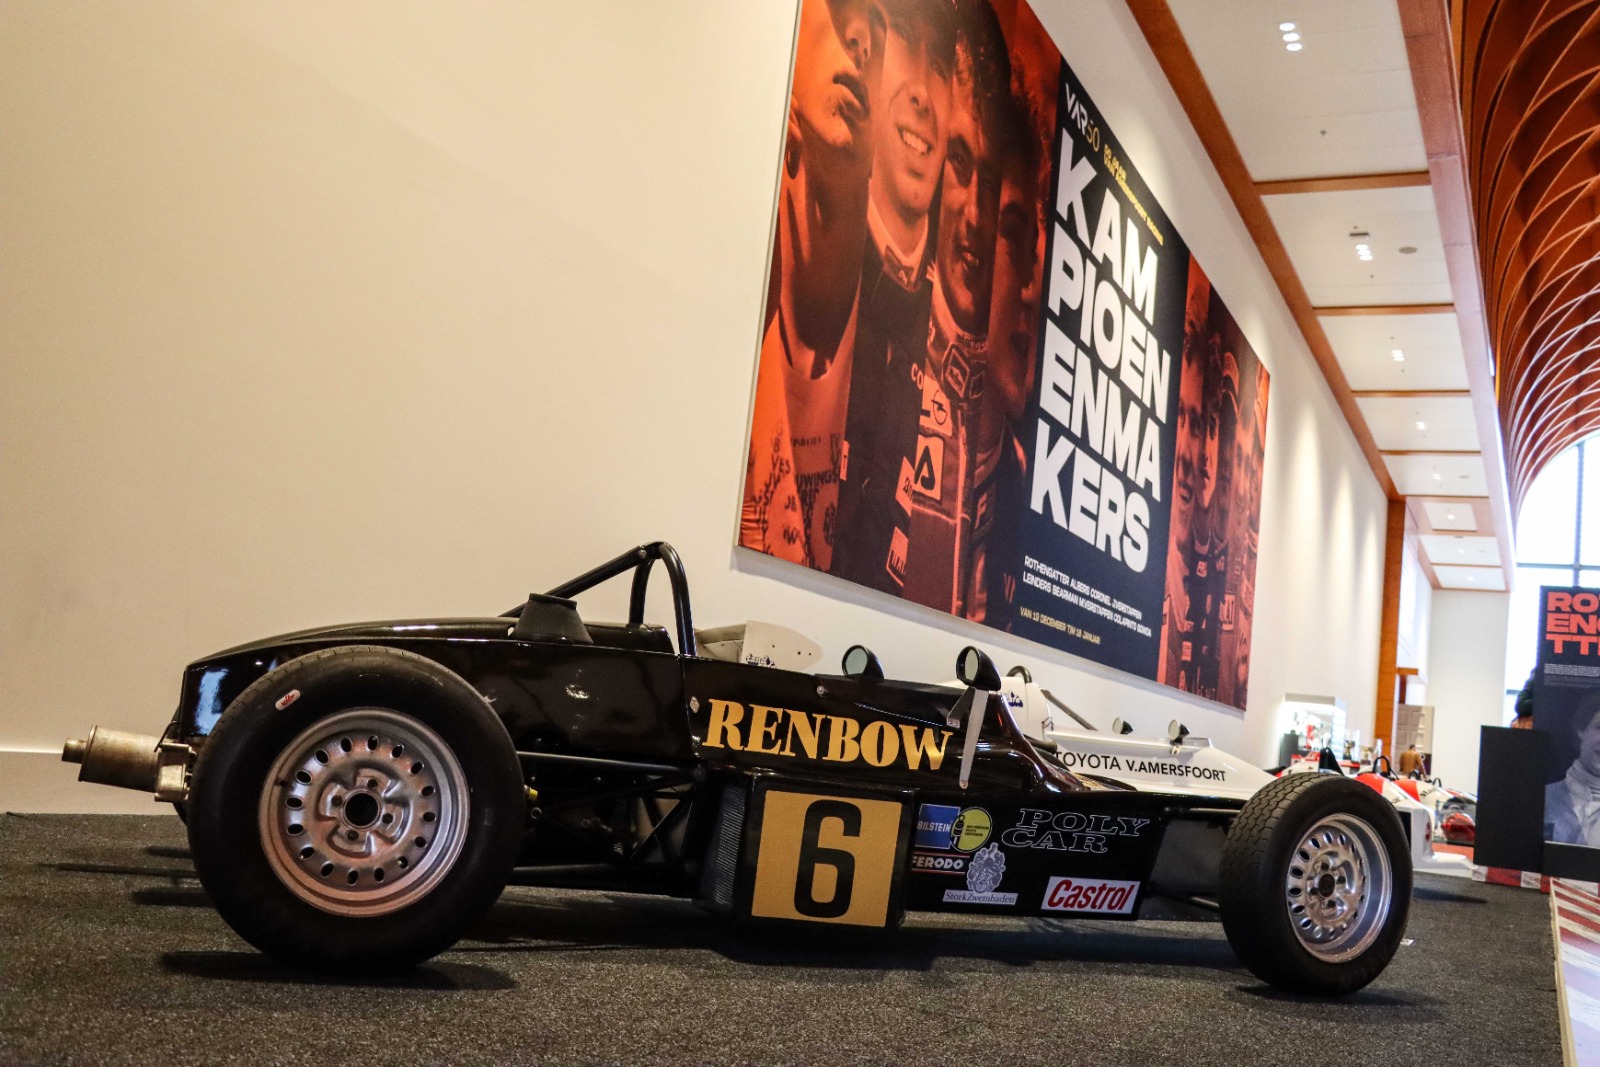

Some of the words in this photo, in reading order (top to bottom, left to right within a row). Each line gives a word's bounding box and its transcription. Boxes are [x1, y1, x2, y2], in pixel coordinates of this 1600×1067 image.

[1055, 127, 1158, 325] KAM
[1048, 221, 1171, 424] PIOEN
[1039, 318, 1161, 502] ENMA
[1030, 418, 1151, 573] KERS
[1024, 554, 1070, 586] ROTHENGATTER
[1070, 577, 1090, 596] ALBERS
[1090, 588, 1111, 607] CORONEL
[1022, 571, 1052, 593] LEINDERS
[1051, 584, 1079, 605] BEARMAN
[1113, 612, 1137, 631] COLAPINTO
[1547, 591, 1600, 613] RO
[1020, 606, 1033, 619] VAN
[1032, 611, 1040, 622] 19
[1040, 613, 1067, 632] DECEMBER
[1546, 612, 1600, 635] EN
[1545, 633, 1600, 656] TT
[702, 698, 953, 771] RENBOW
[1055, 751, 1121, 771] TOYOTA
[1126, 759, 1226, 782] V.AMERSFOORT
[917, 820, 951, 833] BILSTEIN
[1016, 808, 1150, 837] POLY
[1001, 827, 1109, 853] CAR
[794, 799, 862, 918] 6
[1047, 879, 1135, 911] Castrol
